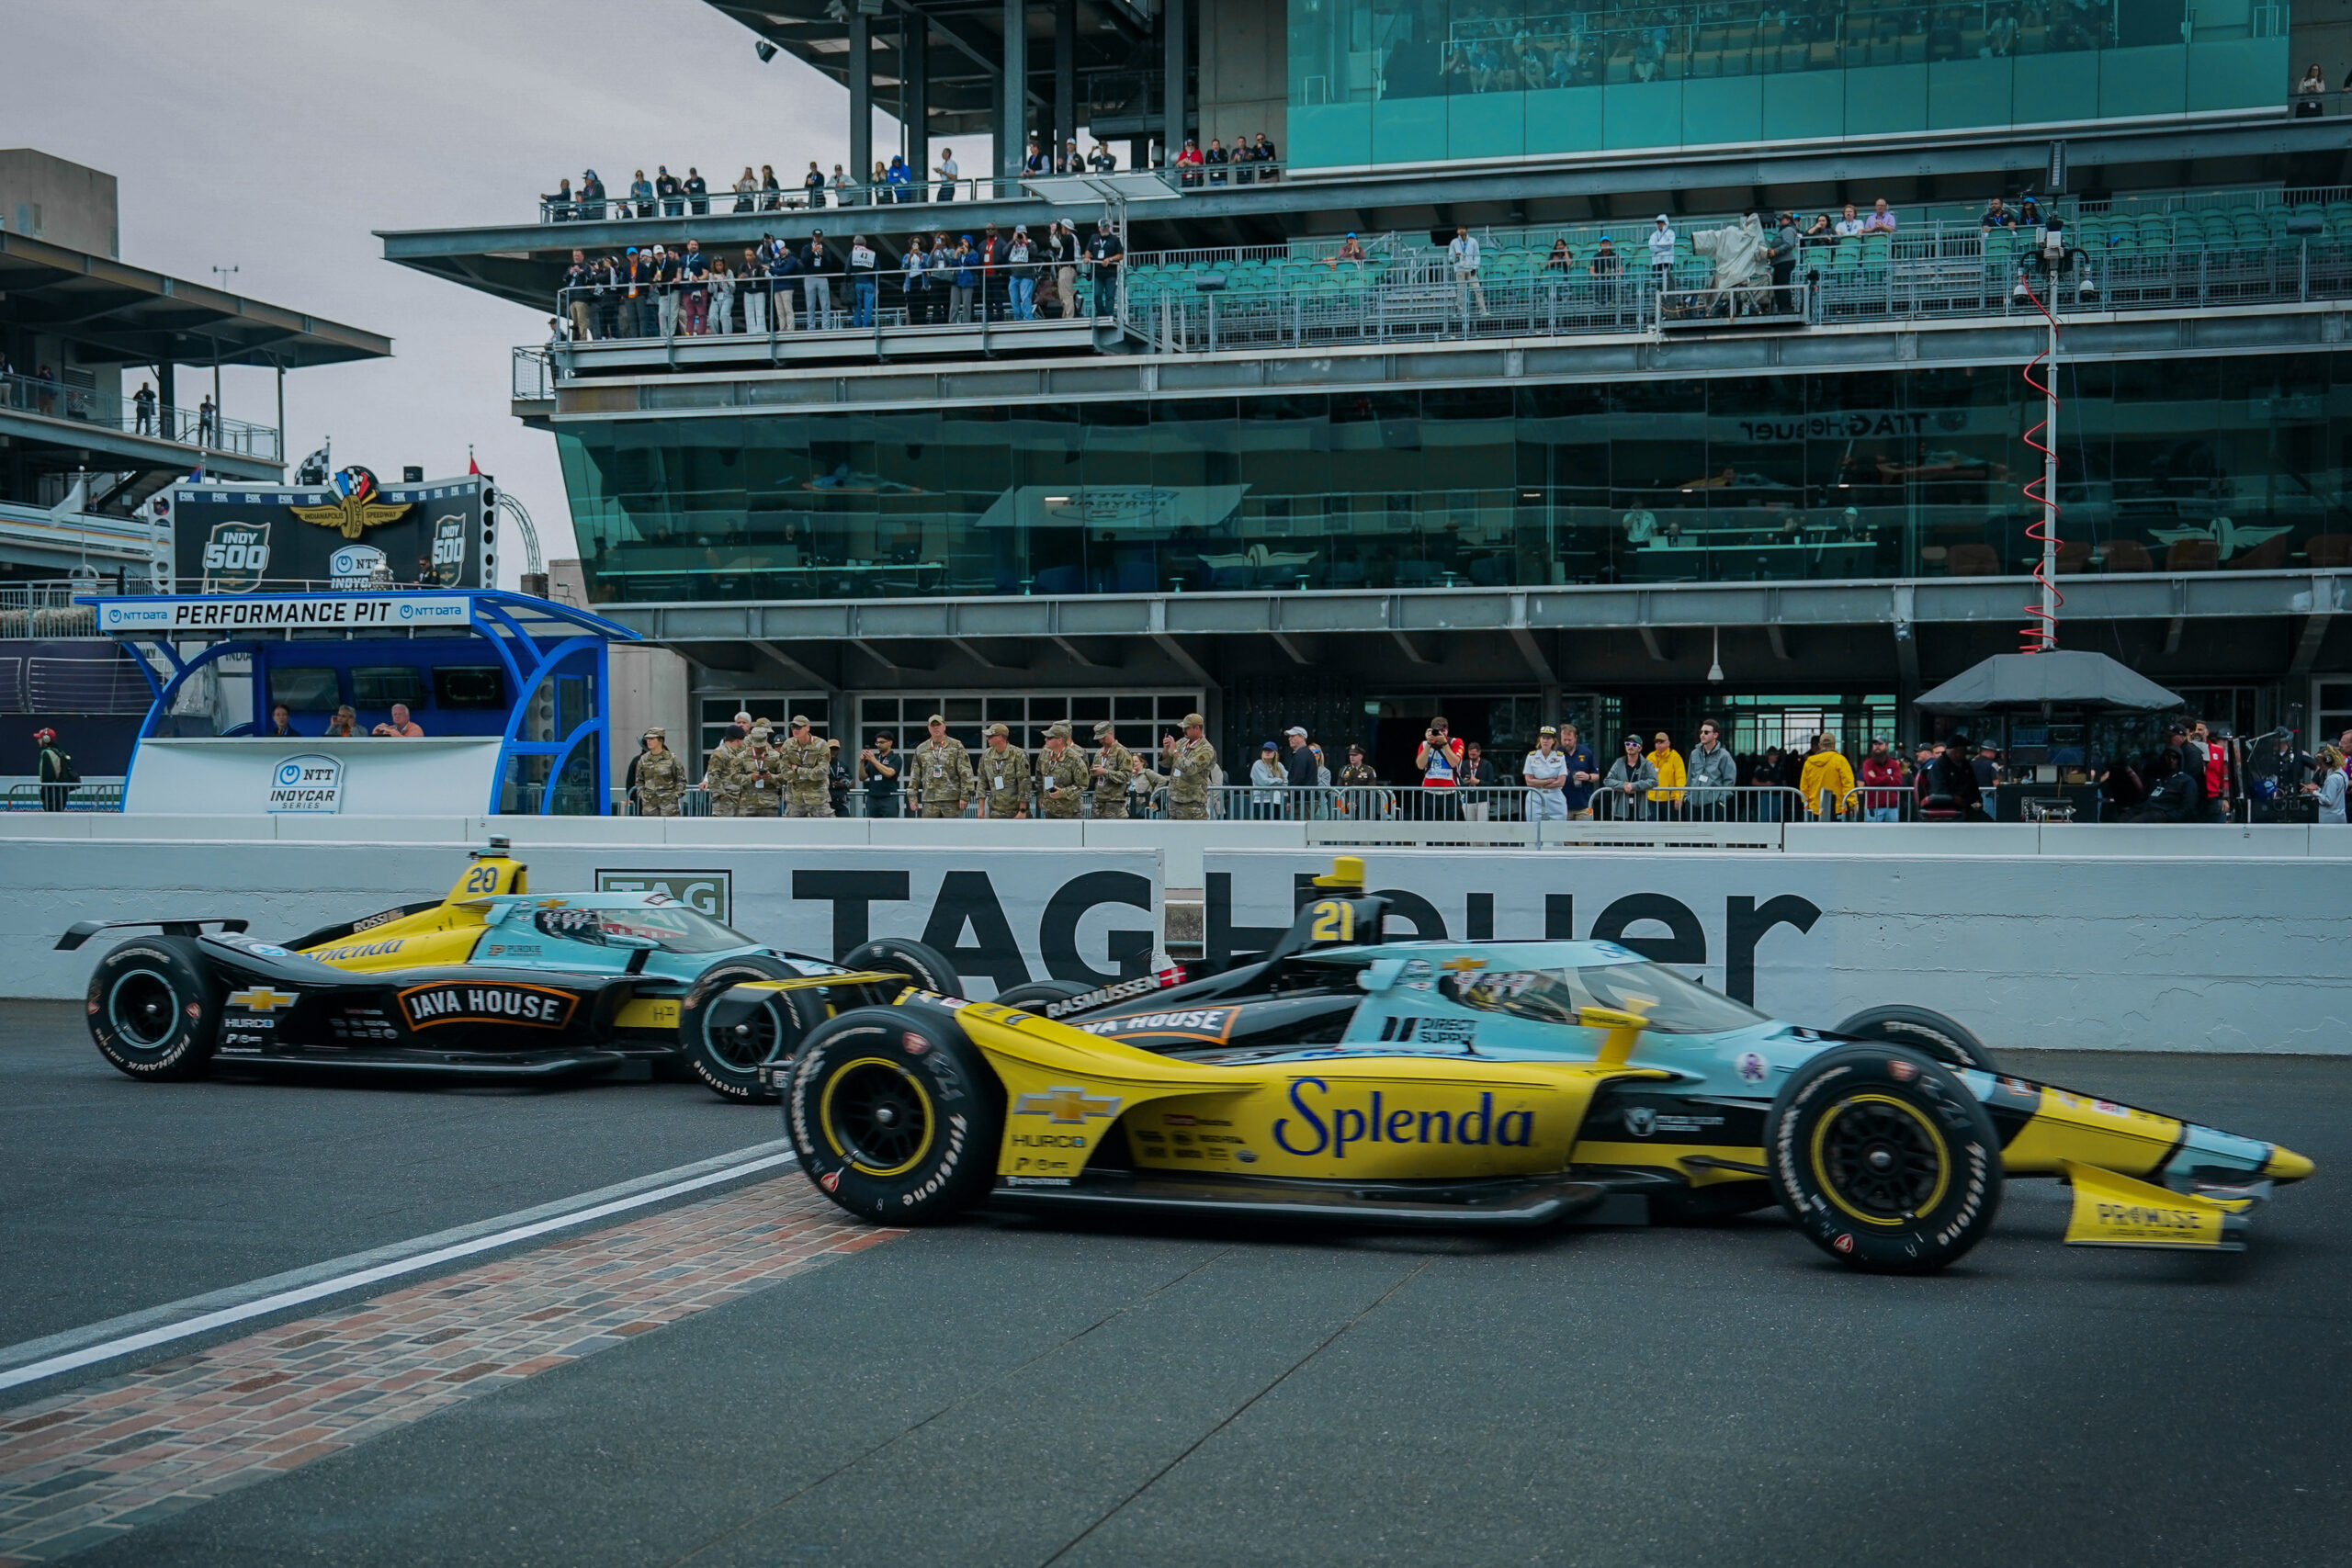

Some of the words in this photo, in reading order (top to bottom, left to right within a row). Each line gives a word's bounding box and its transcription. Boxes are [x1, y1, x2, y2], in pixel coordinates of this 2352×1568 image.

[304, 511, 345, 520] INDIANAPOLIS
[353, 500, 362, 534] MOTOR
[367, 511, 397, 519] SPEEDWAY
[222, 532, 258, 544] INDY
[442, 525, 459, 538] INDY
[206, 544, 268, 570] 500
[434, 537, 464, 564] 500
[175, 603, 346, 625] PERFORMANCE
[355, 603, 391, 621] PIT
[415, 607, 435, 616] NTT
[303, 769, 334, 781] NTT
[270, 790, 335, 801] INDYCAR
[467, 866, 498, 893] 20
[353, 911, 391, 934] ROSSI
[792, 870, 1155, 996] TAG
[1311, 900, 1355, 941] 21
[411, 989, 463, 1020] JAVA
[468, 989, 560, 1021] HOUSE
[224, 1018, 275, 1029] HURCO
[1079, 1016, 1118, 1035] VA
[1126, 1010, 1227, 1032] HOUSE
[1419, 1018, 1478, 1030] DIRECT
[127, 1033, 191, 1072] FIREHAWK
[693, 1059, 750, 1097] Firestone
[1272, 1077, 1537, 1158] Splenda
[1012, 1134, 1087, 1148] HURCO
[902, 1112, 968, 1206] Firestone
[1936, 1141, 1986, 1247] Firestone
